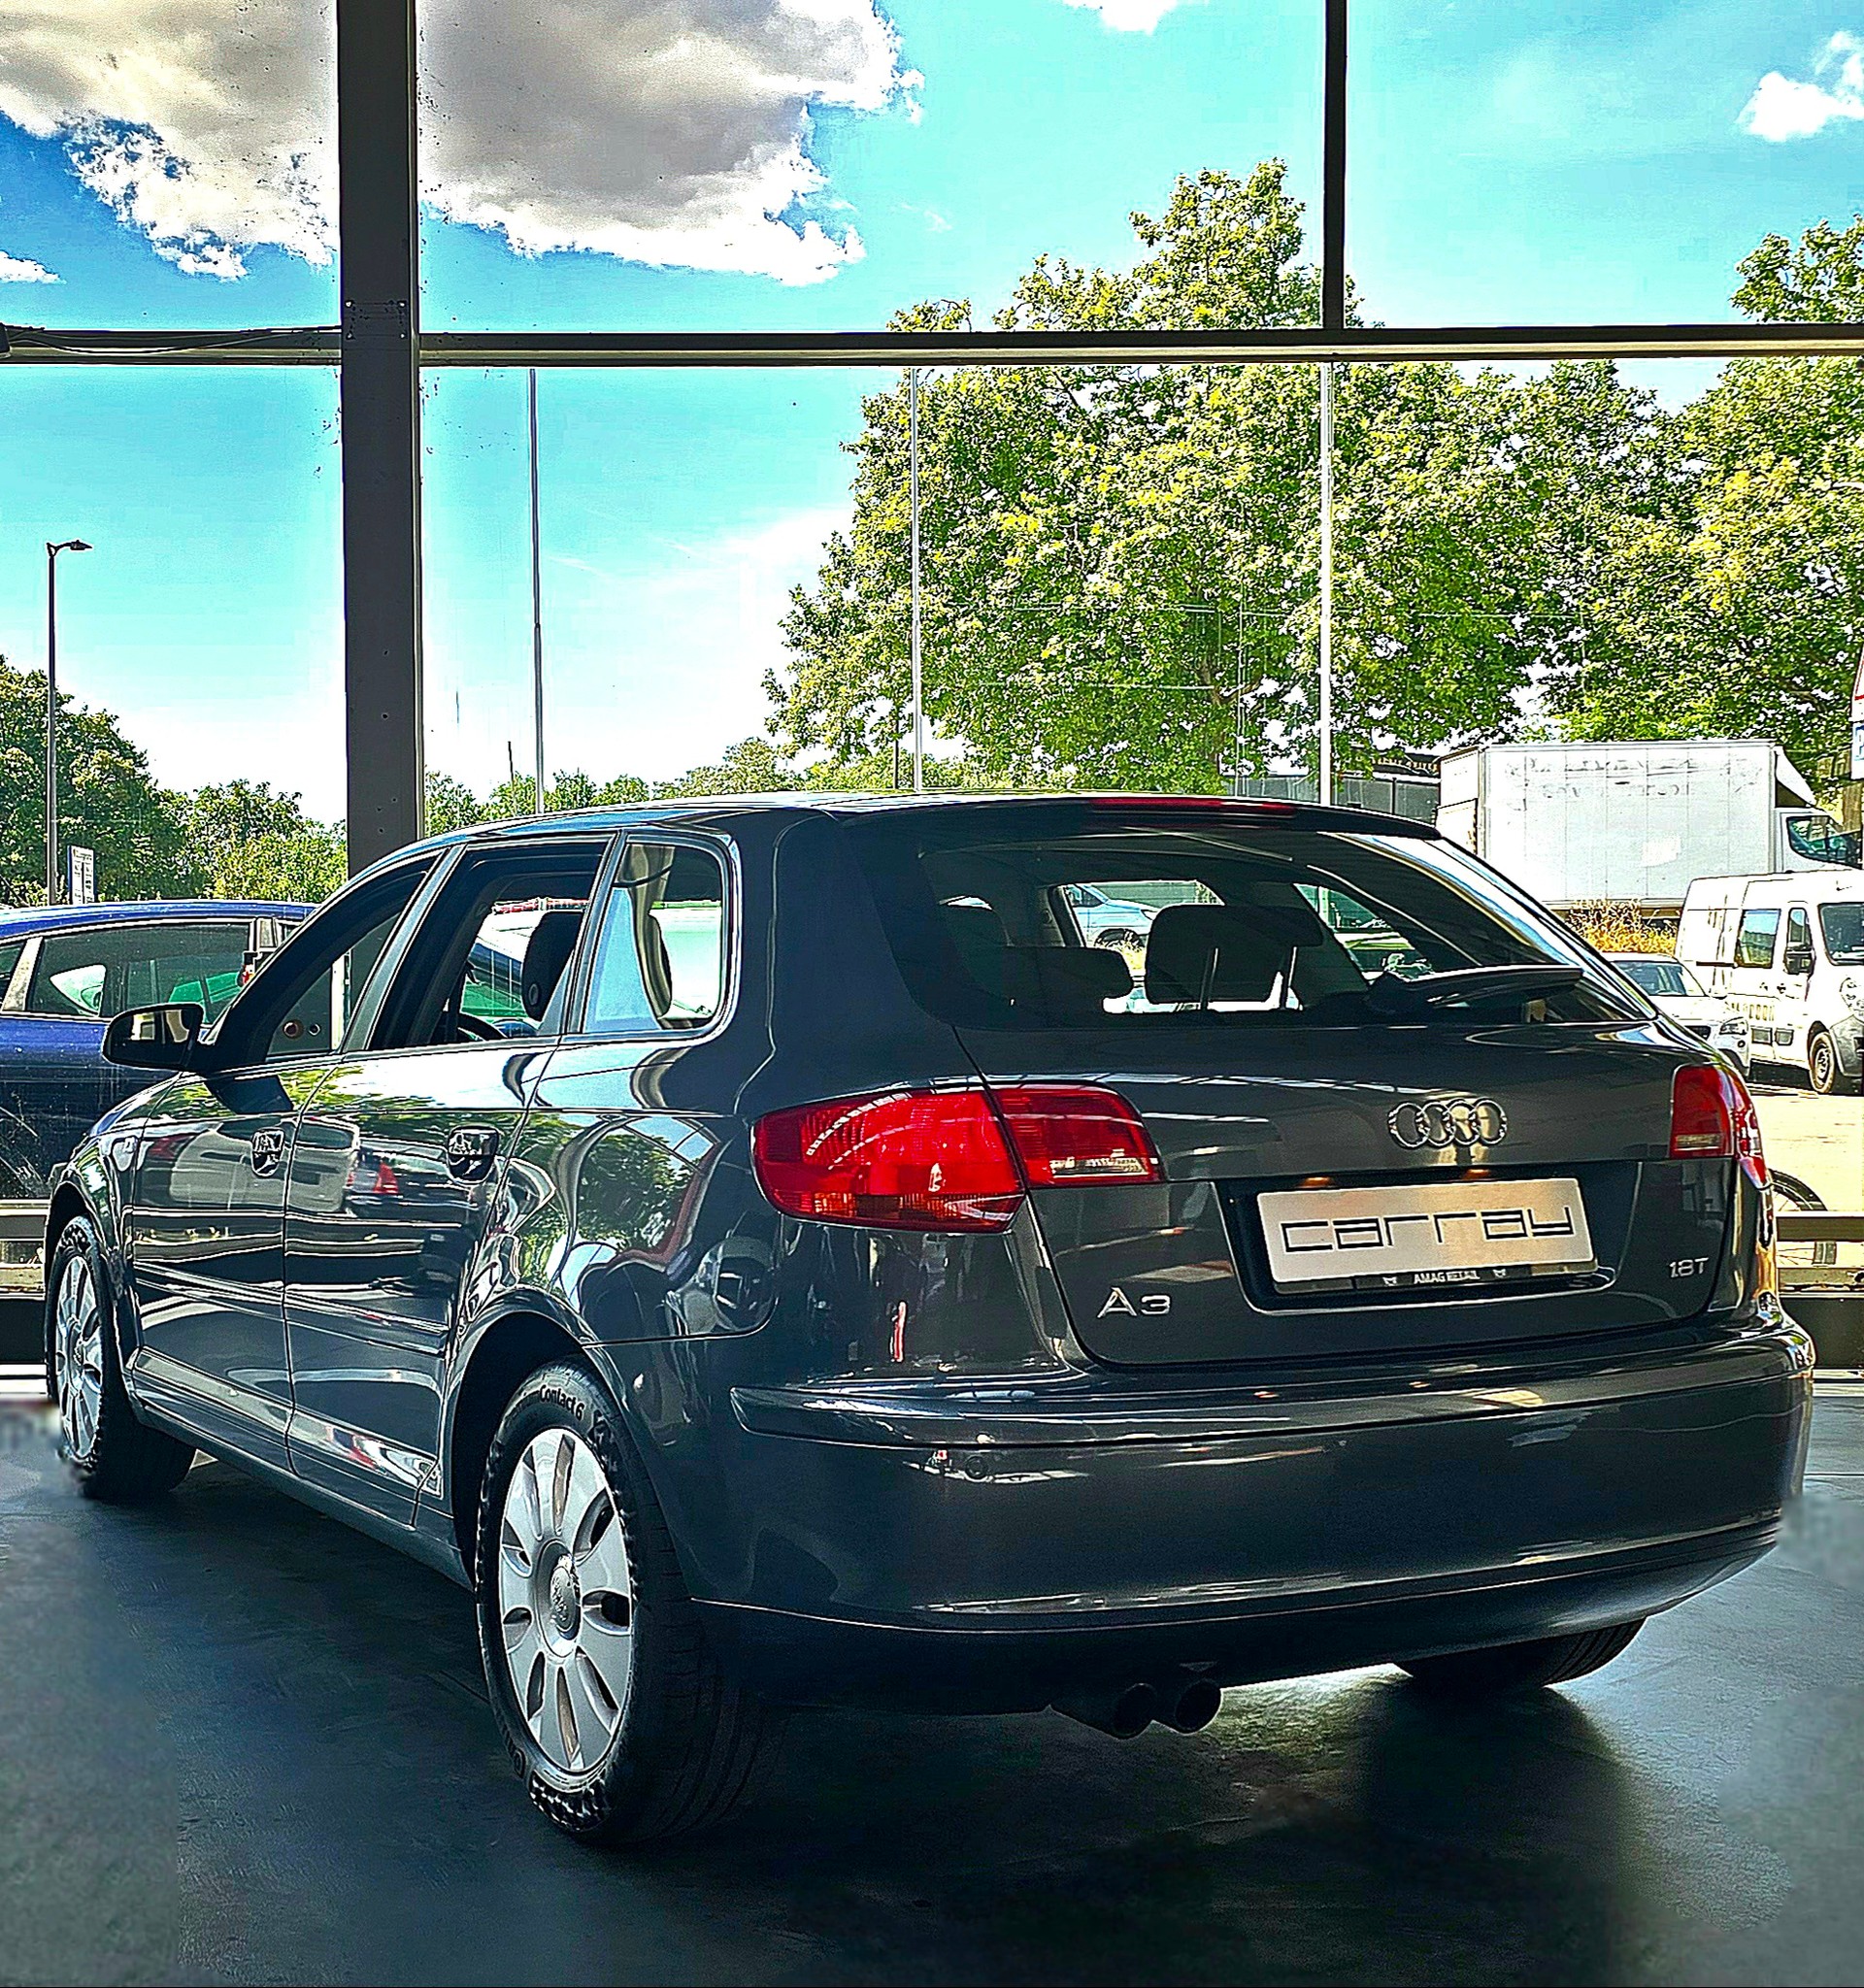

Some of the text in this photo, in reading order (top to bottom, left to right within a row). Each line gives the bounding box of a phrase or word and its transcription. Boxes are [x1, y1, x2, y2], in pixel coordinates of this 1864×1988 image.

[1280, 1206, 1575, 1253] carray
[1414, 1272, 1446, 1284] AMAG
[1096, 1286, 1171, 1319] A3
